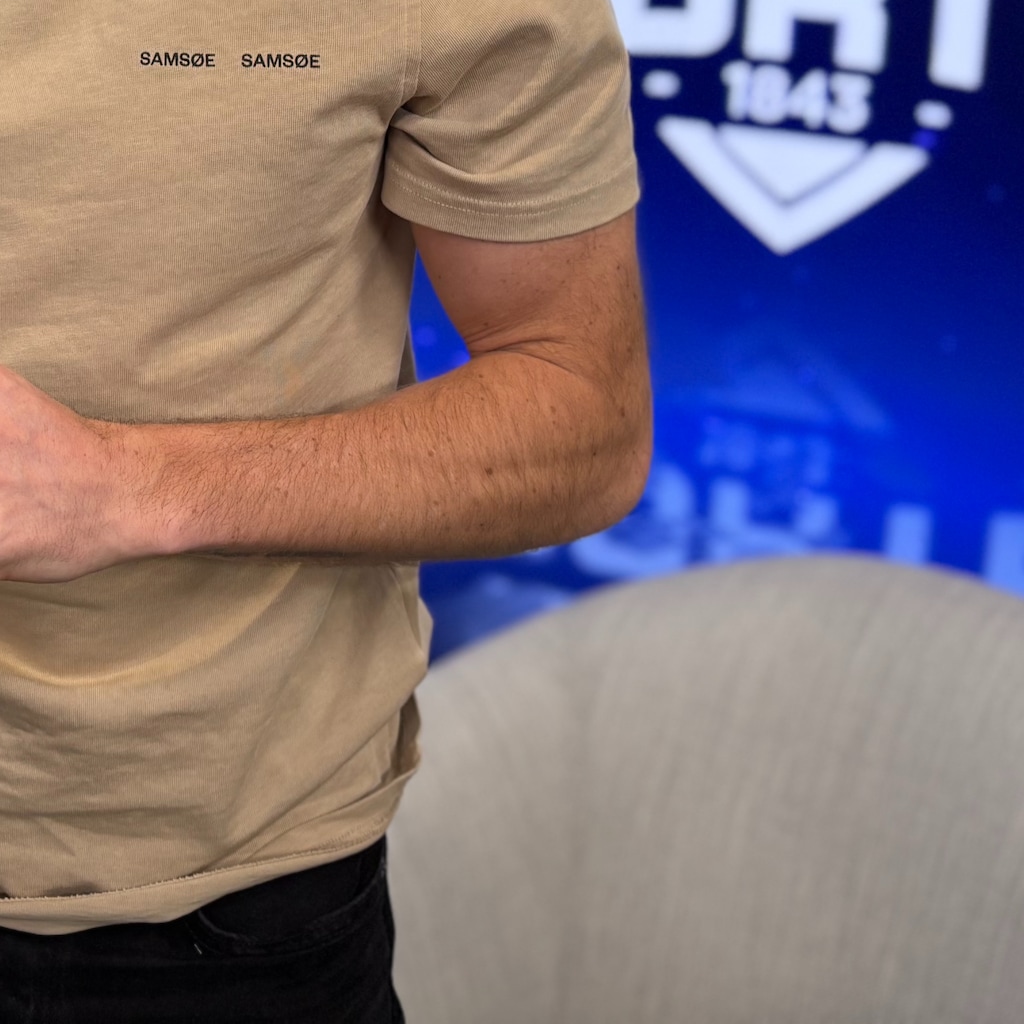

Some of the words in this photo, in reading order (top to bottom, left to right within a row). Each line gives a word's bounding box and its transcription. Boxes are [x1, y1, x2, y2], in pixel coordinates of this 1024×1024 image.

[140, 51, 216, 68] SAMSØE
[241, 53, 321, 69] SAMSØE
[720, 60, 874, 135] 1843
